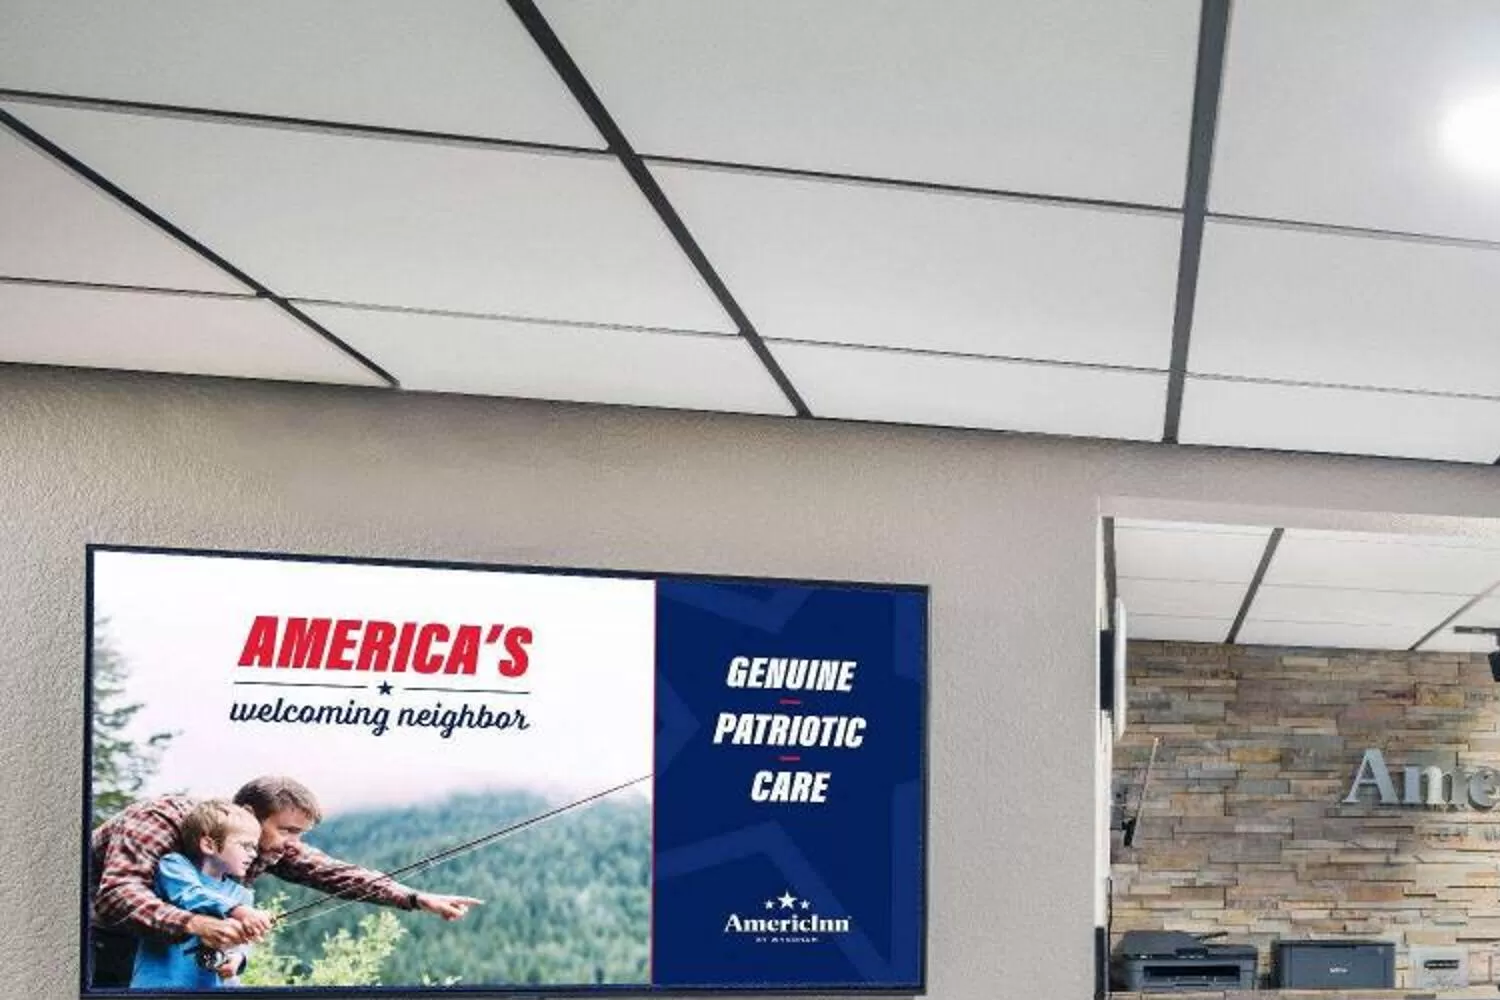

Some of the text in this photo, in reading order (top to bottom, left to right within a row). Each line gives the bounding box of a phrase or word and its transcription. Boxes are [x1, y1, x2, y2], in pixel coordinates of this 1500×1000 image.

[237, 615, 533, 677] AMERICA'S
[726, 656, 857, 691] GENUINE
[229, 697, 531, 739] welcoming neighbor
[713, 712, 867, 749] PATRIOTIC
[750, 770, 832, 803] CARE
[723, 912, 850, 933] AmericInn
